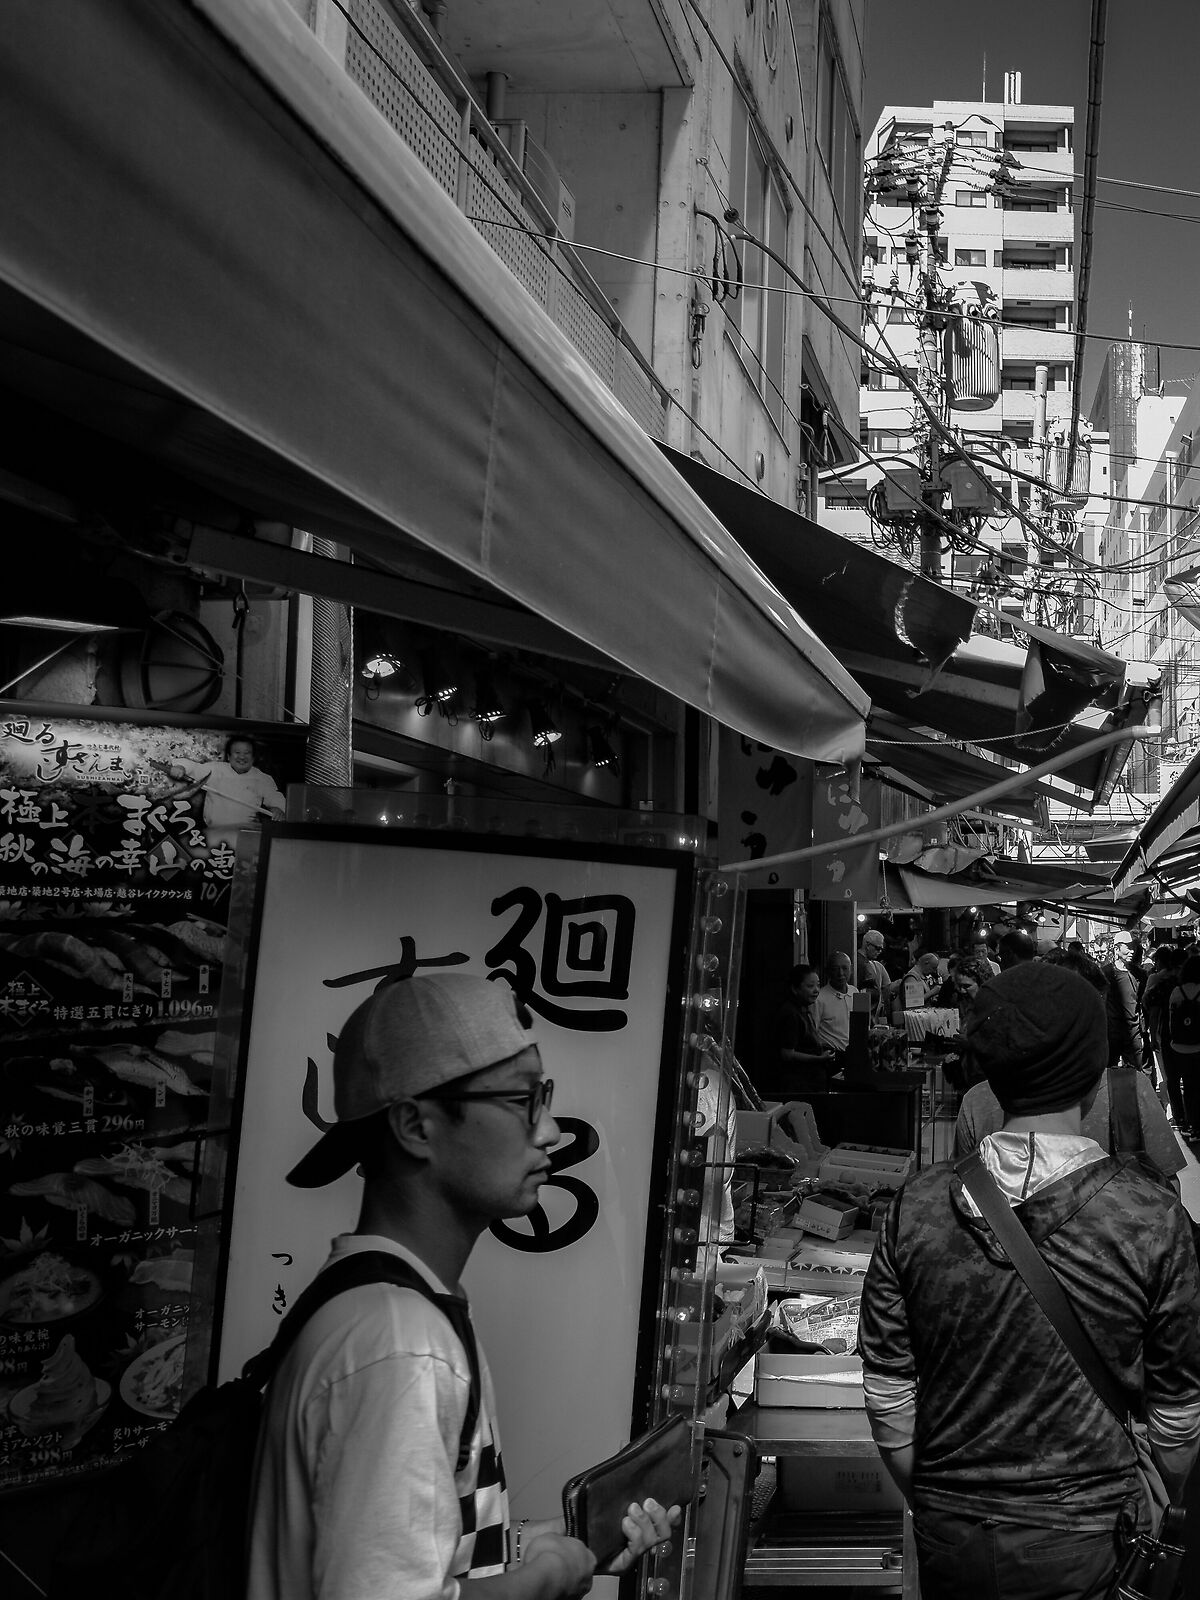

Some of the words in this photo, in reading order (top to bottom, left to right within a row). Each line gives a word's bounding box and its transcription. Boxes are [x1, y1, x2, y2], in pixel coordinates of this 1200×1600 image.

[5, 1119, 98, 1138] 秋の味覚三貫
[101, 1113, 145, 1133] 296円
